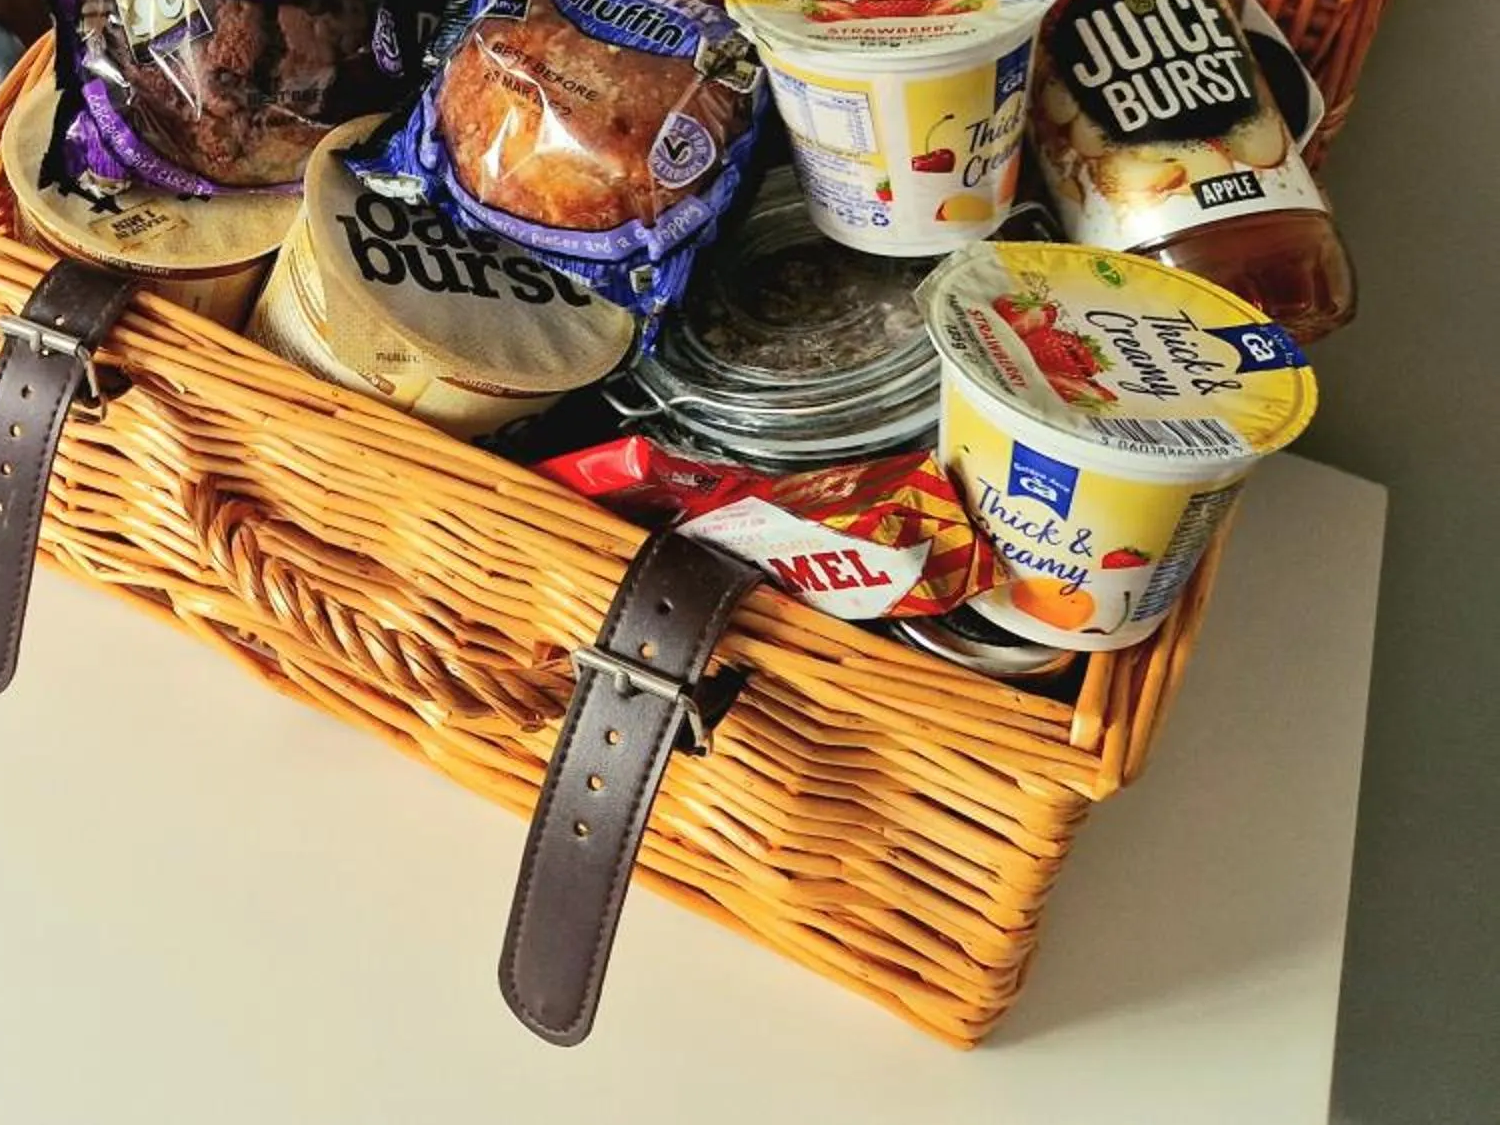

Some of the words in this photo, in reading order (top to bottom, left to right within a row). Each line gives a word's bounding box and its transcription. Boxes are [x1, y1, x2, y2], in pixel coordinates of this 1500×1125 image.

[533, 62, 598, 101] BEFORE
[1102, 51, 1252, 133] BURST
[1200, 174, 1257, 205] APPLE
[336, 215, 592, 308] burst
[1085, 309, 1180, 402] Creamy
[1141, 309, 1206, 378] Thick
[1192, 375, 1242, 395] &
[977, 477, 1062, 547] Thick
[1070, 527, 1094, 557] &
